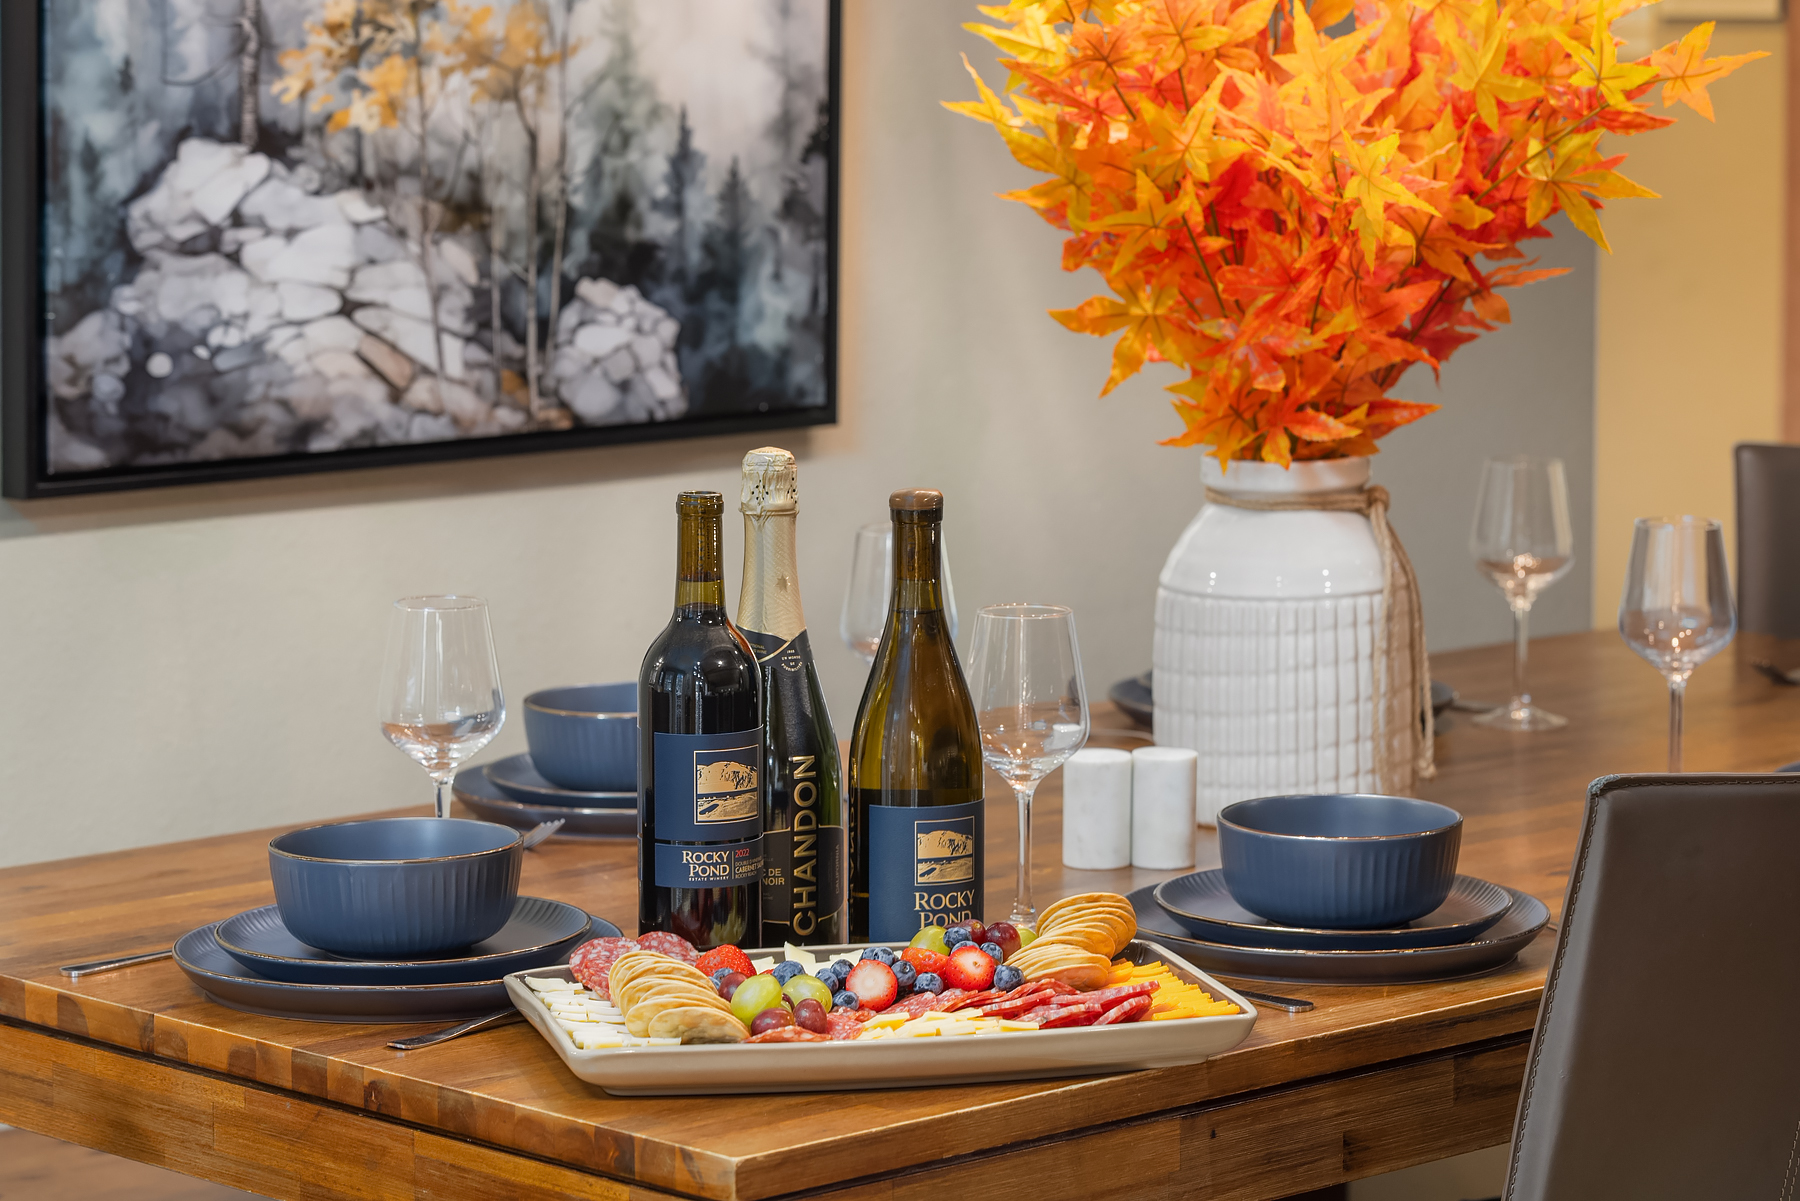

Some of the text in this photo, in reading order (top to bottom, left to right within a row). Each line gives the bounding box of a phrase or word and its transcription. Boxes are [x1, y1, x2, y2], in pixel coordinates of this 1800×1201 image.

[793, 755, 817, 936] CHANDON
[682, 850, 730, 863] ROCKY
[735, 848, 750, 858] 2022
[689, 864, 730, 877] POND
[735, 863, 757, 873] CABERNET
[768, 868, 782, 876] DE
[913, 889, 975, 911] ROCKY
